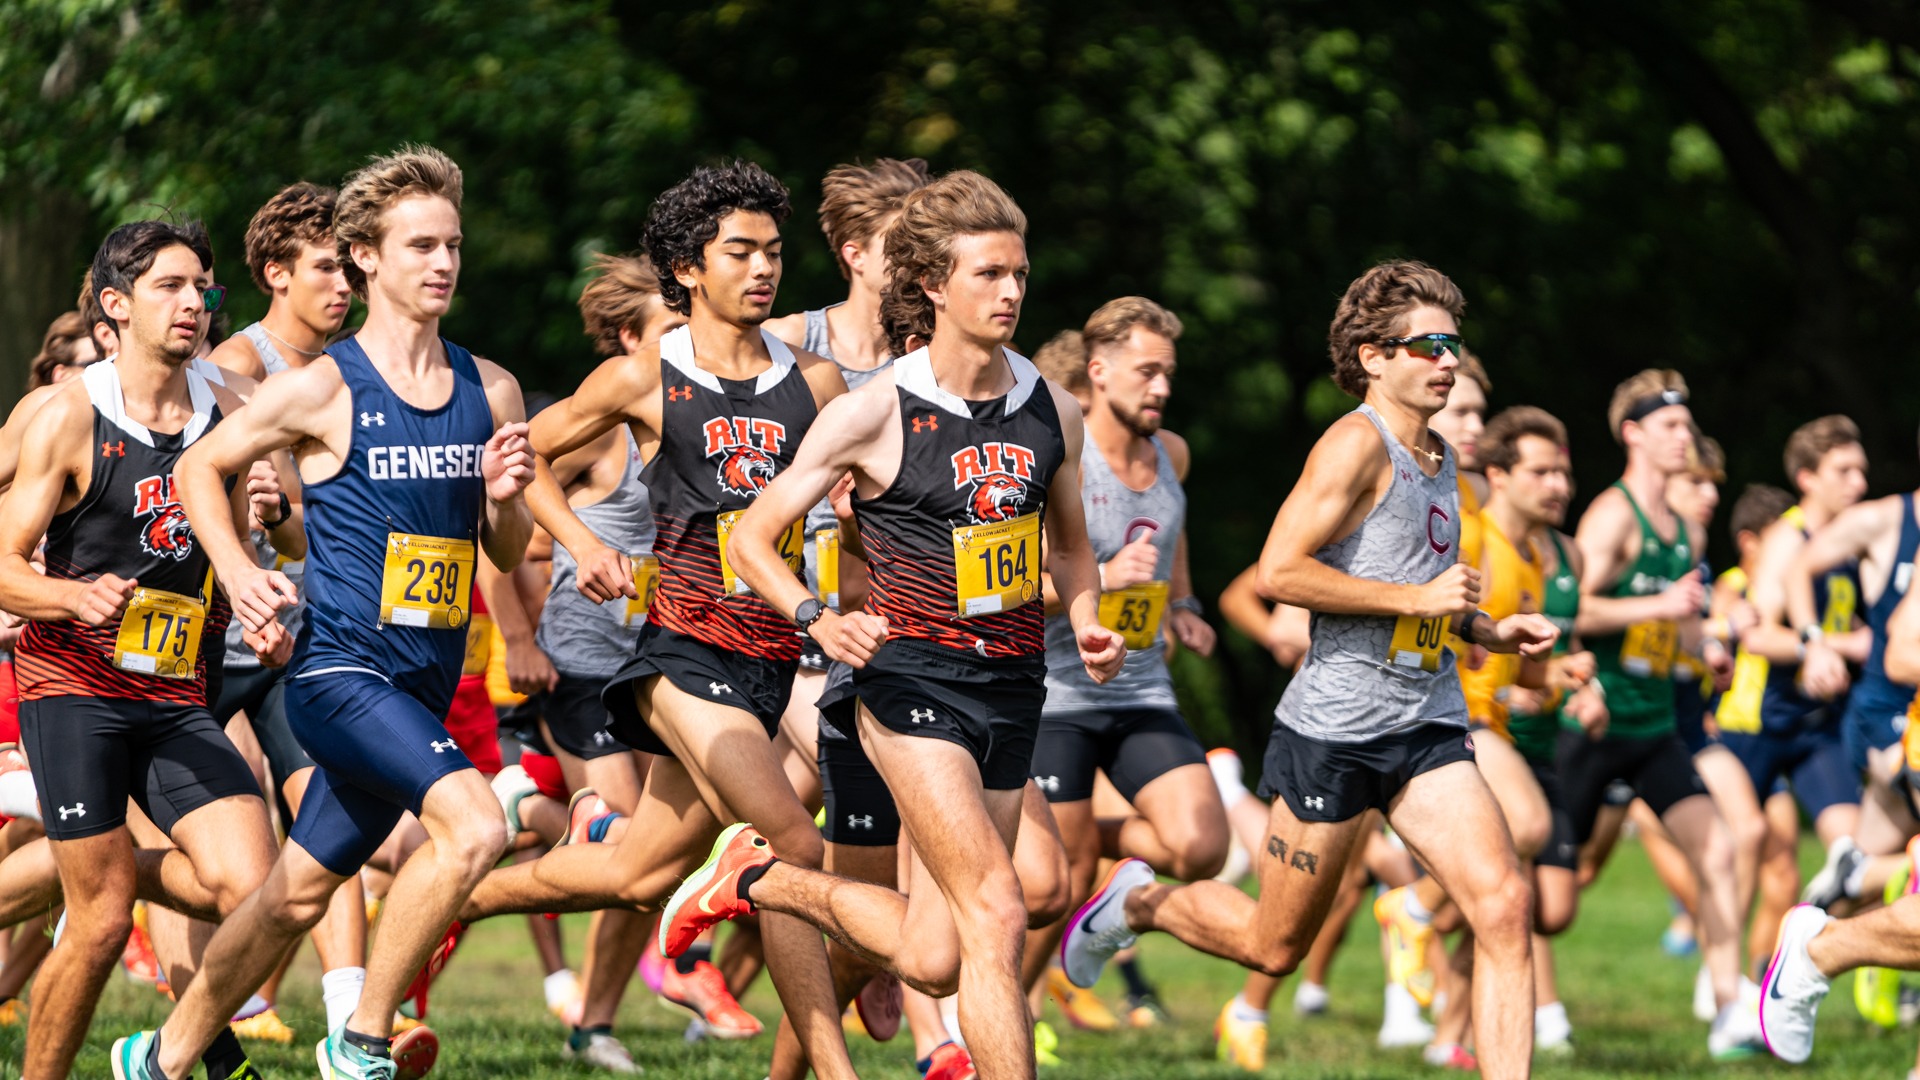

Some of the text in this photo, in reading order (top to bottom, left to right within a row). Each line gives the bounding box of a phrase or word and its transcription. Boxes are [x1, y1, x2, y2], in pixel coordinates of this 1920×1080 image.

[703, 416, 786, 458] RIT
[951, 442, 1036, 491] RIT
[133, 474, 181, 518] RI
[1427, 502, 1451, 556] C
[404, 558, 459, 605] 239
[979, 538, 1028, 590] 164
[142, 611, 191, 657] 175
[1116, 598, 1151, 632] 53
